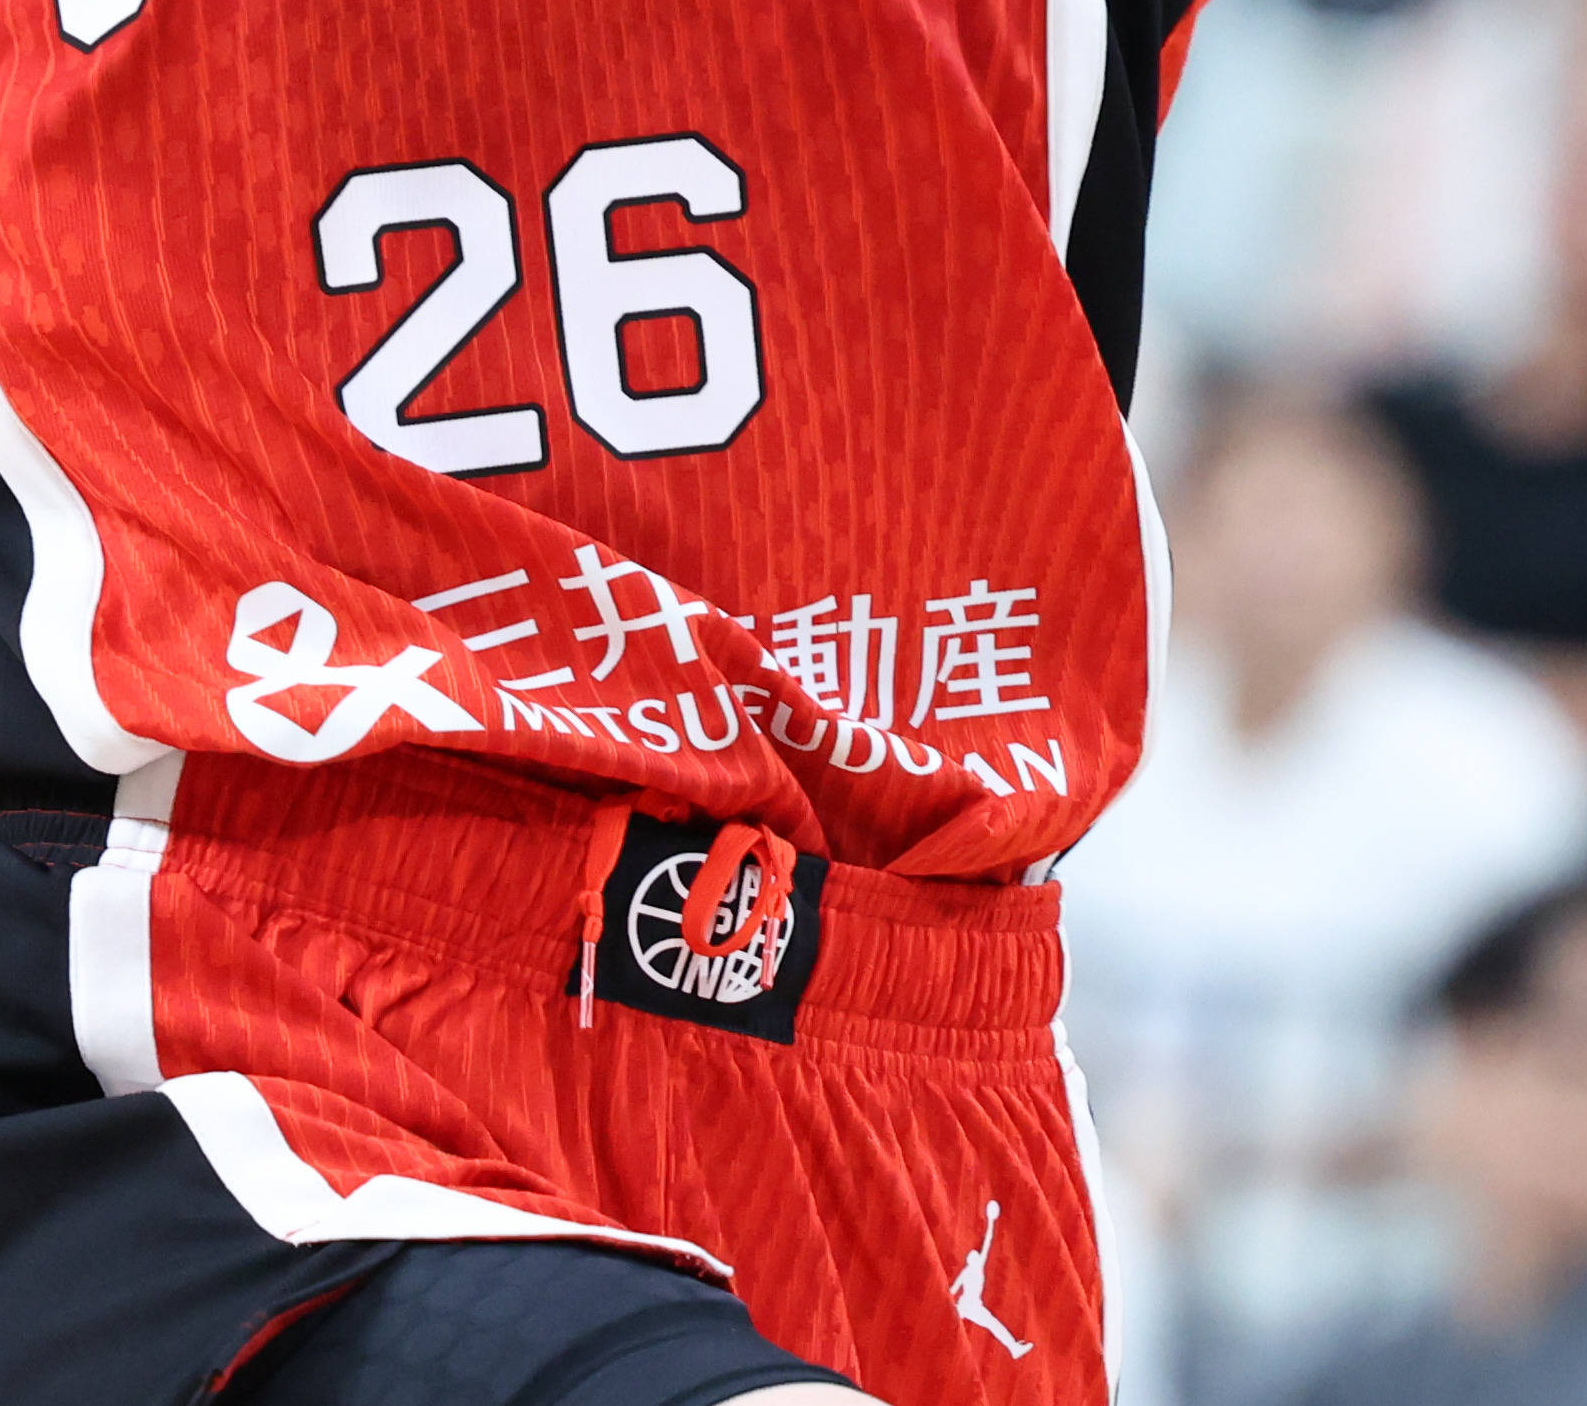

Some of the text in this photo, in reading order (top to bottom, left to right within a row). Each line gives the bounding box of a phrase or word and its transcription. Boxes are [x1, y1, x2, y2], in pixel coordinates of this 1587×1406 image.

[312, 130, 767, 480] 26
[409, 542, 1052, 733] 三井動産
